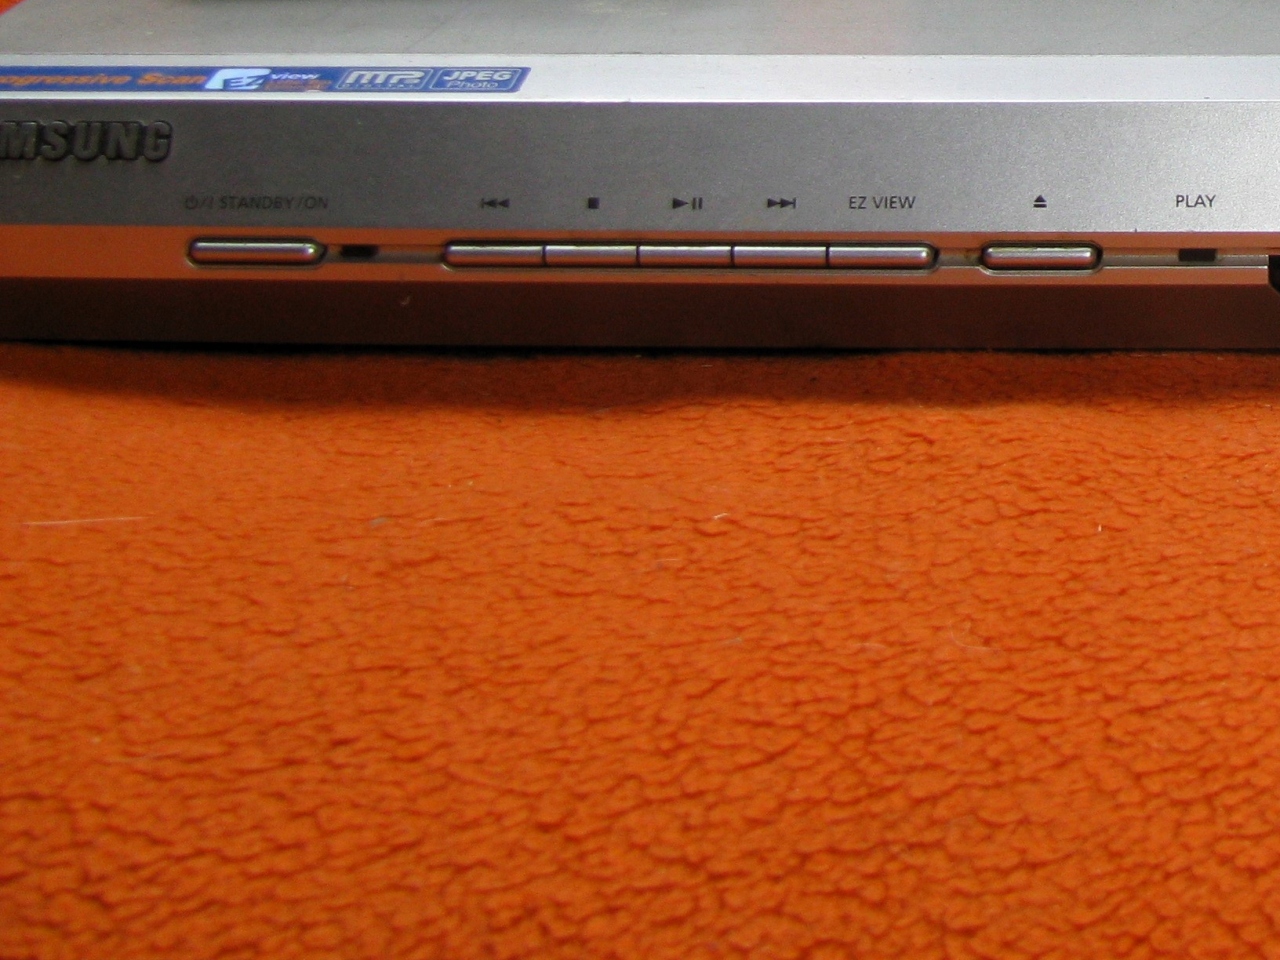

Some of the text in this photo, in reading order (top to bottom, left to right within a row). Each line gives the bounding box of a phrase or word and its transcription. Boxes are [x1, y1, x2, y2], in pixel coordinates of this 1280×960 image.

[271, 72, 319, 80] view
[443, 70, 512, 81] JPEG
[447, 81, 499, 89] Photo
[849, 196, 916, 209] EZ VIEW
[1175, 194, 1217, 208] PLAY
